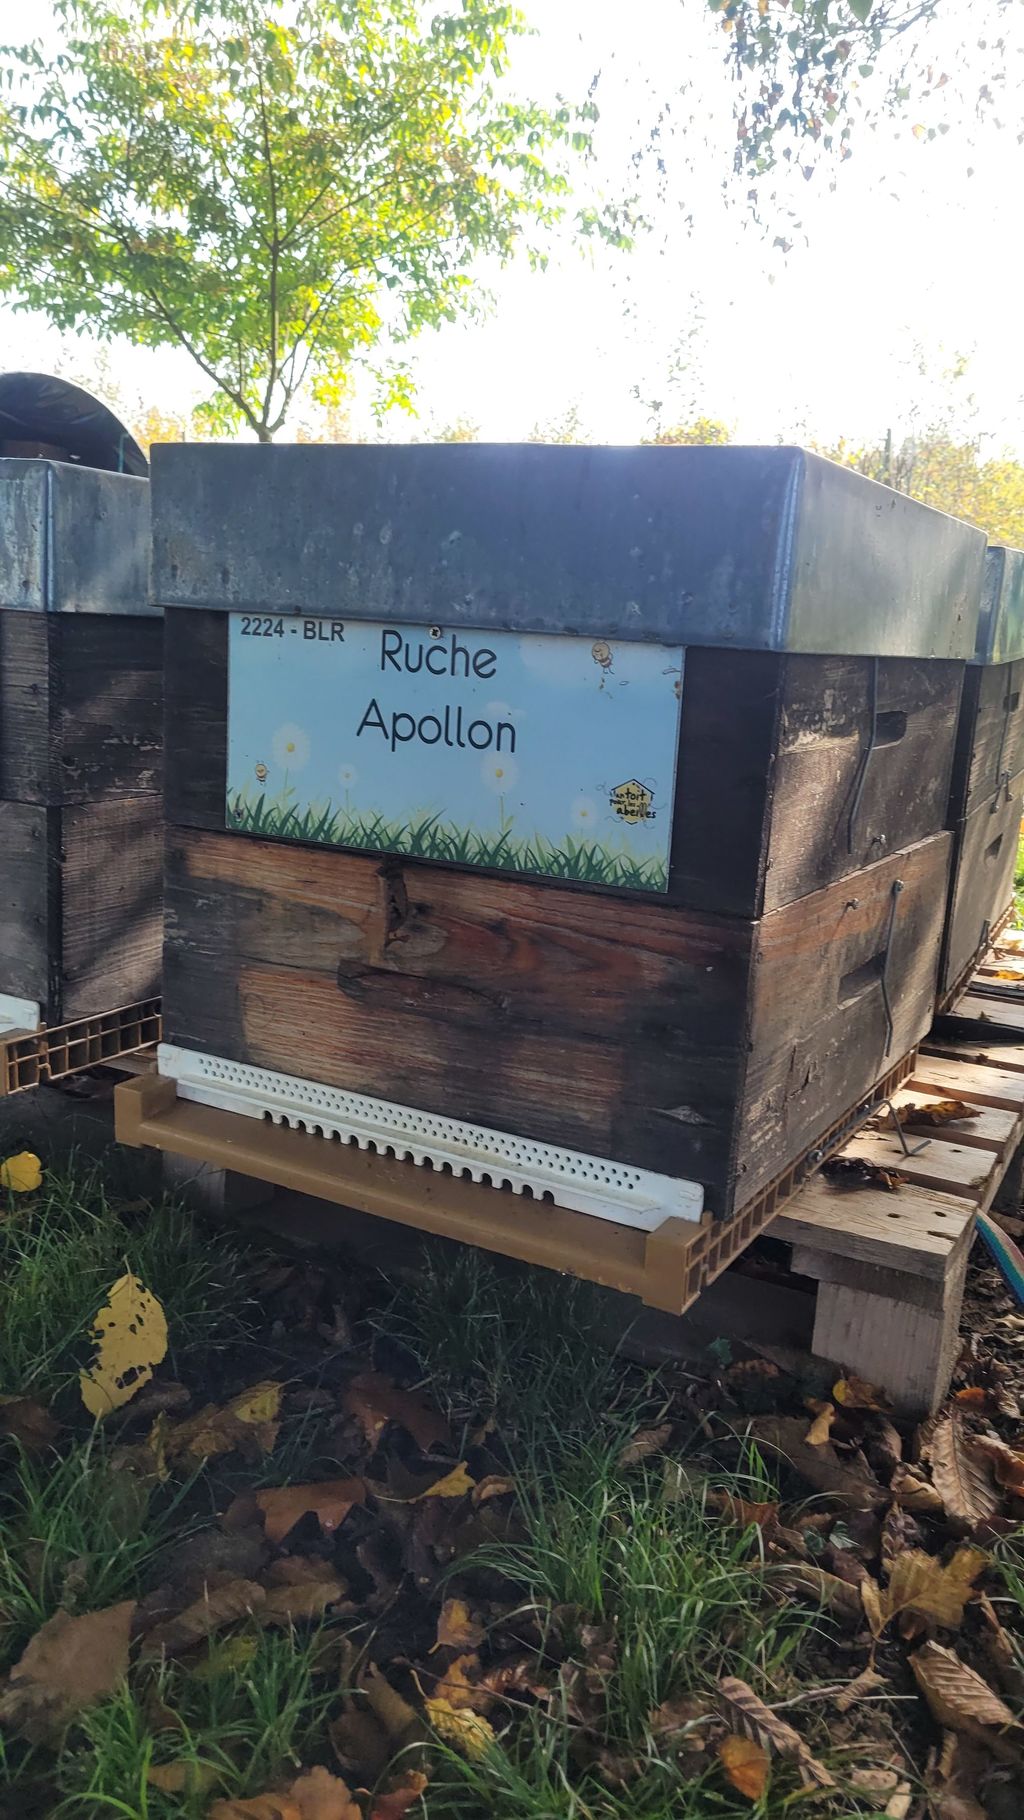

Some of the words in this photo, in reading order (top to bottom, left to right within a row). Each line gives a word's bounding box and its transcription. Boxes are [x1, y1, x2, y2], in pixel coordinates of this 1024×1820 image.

[240, 616, 285, 638] 2224
[303, 620, 345, 642] BLR
[381, 629, 498, 679] Ruche
[356, 698, 516, 753] Apollon
[624, 787, 646, 801] toit
